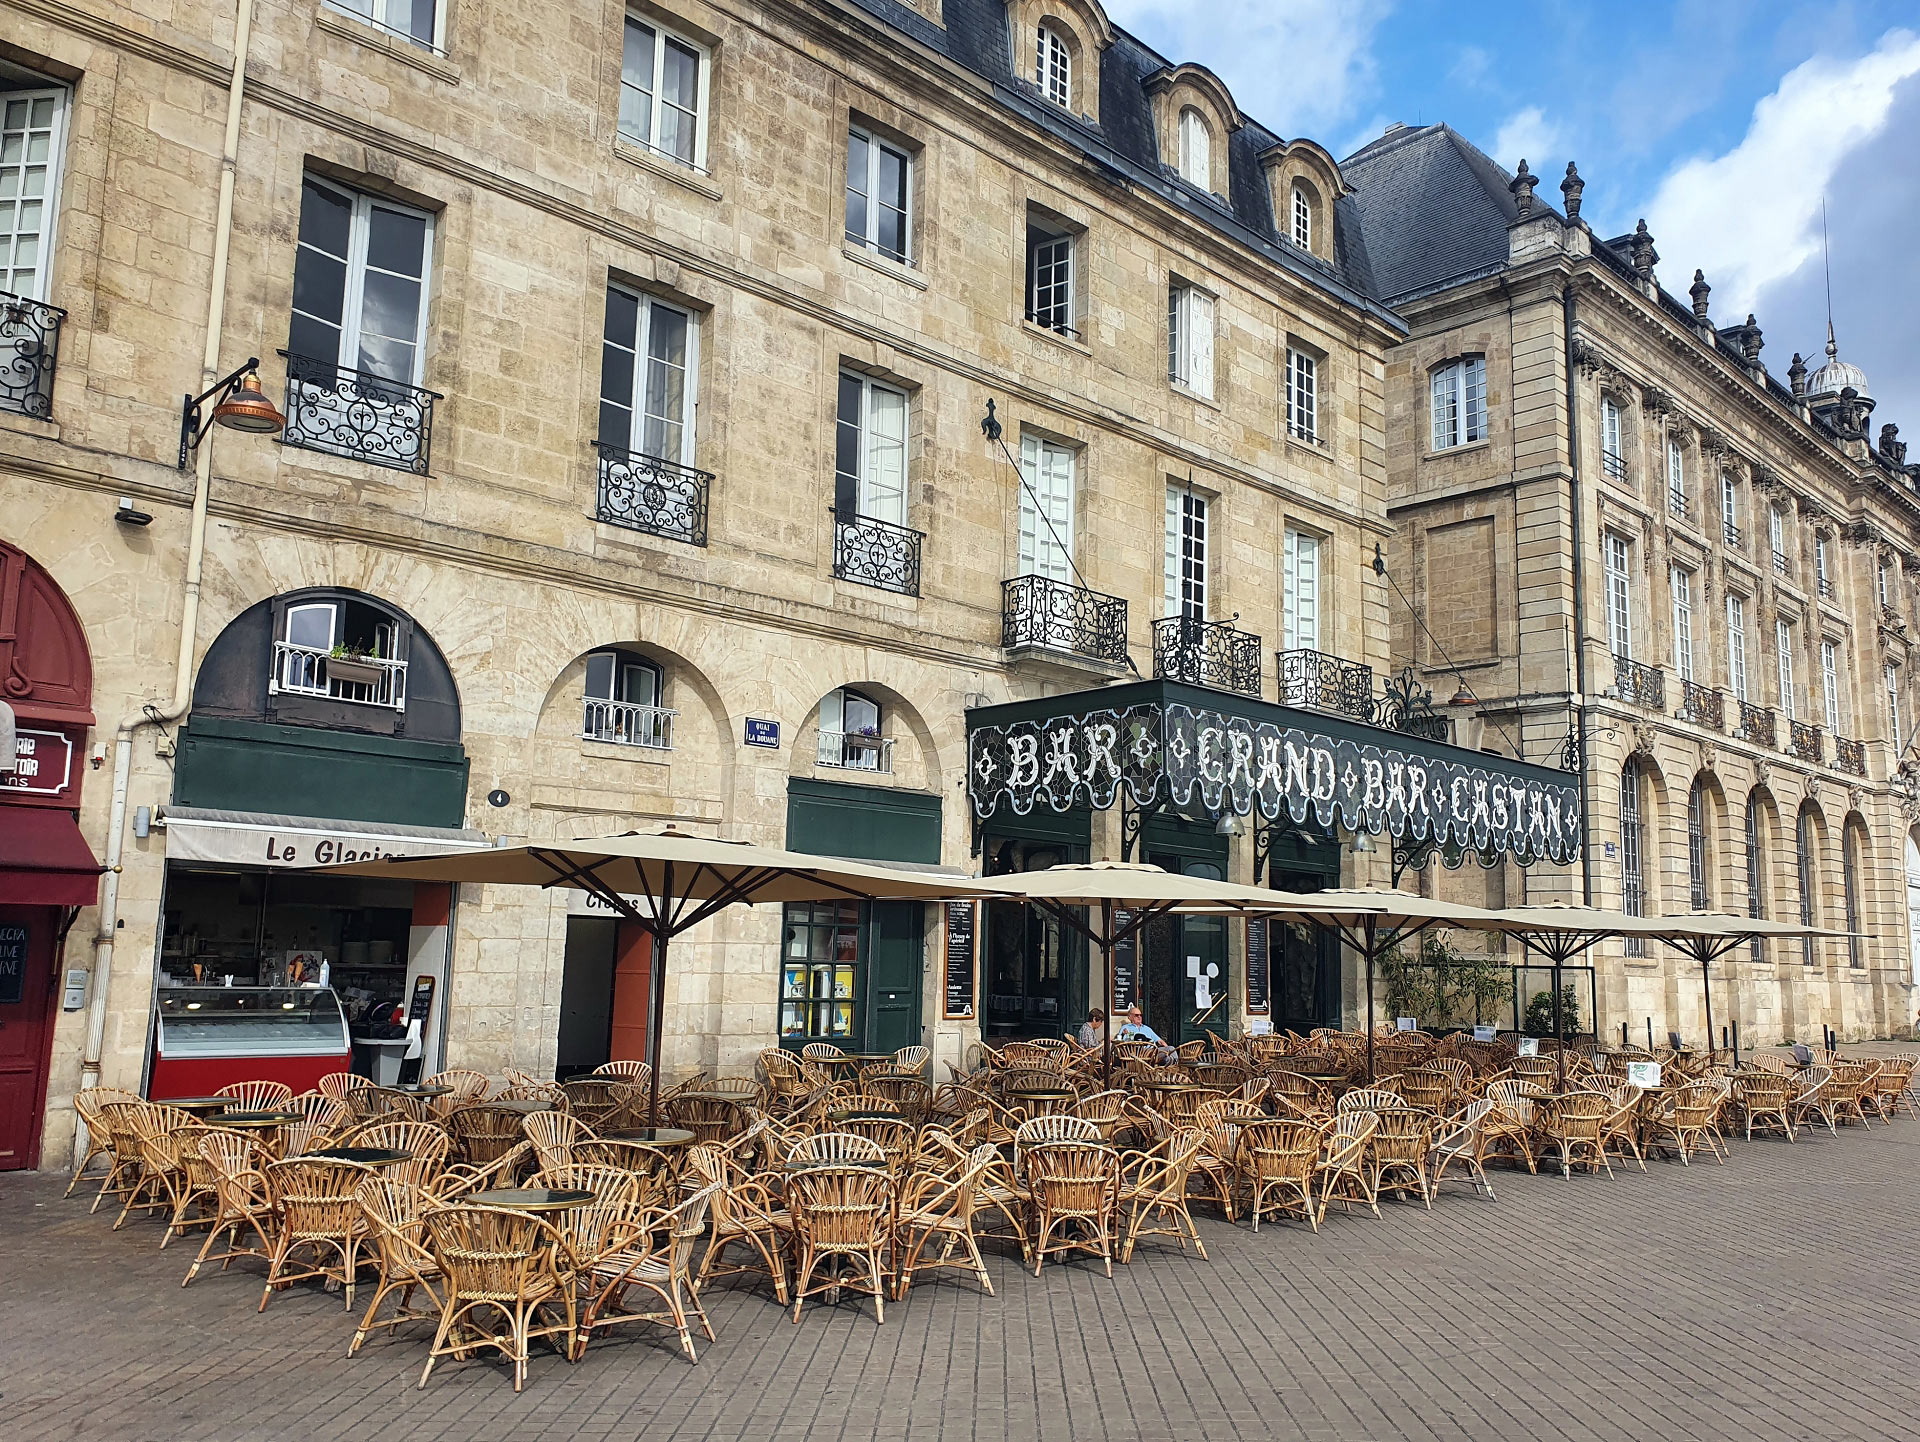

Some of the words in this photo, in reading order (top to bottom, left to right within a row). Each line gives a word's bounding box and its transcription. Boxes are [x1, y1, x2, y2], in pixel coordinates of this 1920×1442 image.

[756, 722, 770, 731] QUAI
[748, 733, 755, 741] LA
[757, 735, 777, 744] DOUANE
[1006, 723, 1122, 790] BAR
[1197, 727, 1337, 801] GRAND
[1361, 757, 1429, 816] BAR
[1451, 776, 1562, 839] CASTAN
[496, 792, 502, 803] 4
[266, 836, 296, 862] Le
[314, 839, 406, 864] Glaci
